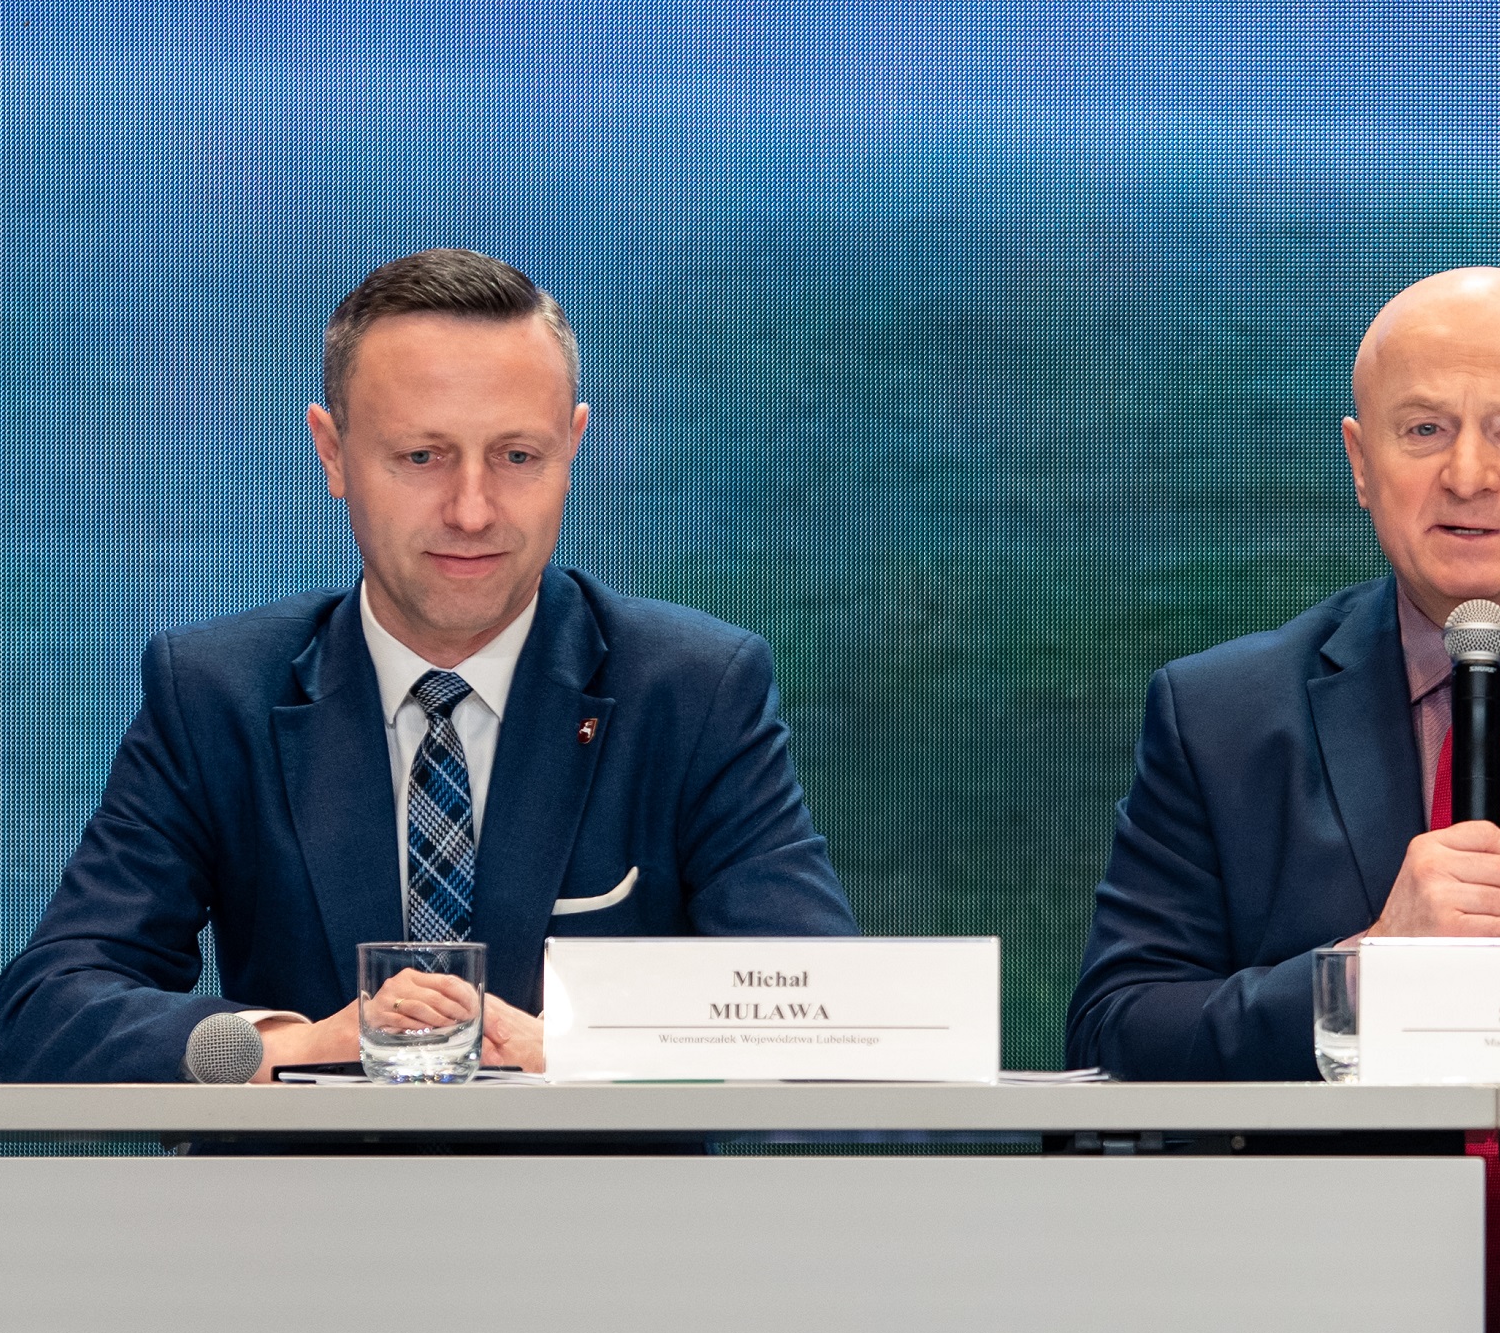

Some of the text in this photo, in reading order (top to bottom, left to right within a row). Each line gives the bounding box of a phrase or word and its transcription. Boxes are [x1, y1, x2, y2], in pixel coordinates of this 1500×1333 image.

[733, 970, 809, 988] Michał
[709, 1003, 830, 1020] MULAWA
[658, 1034, 880, 1047] Wicemarszałek Województwa Lubelskiego
